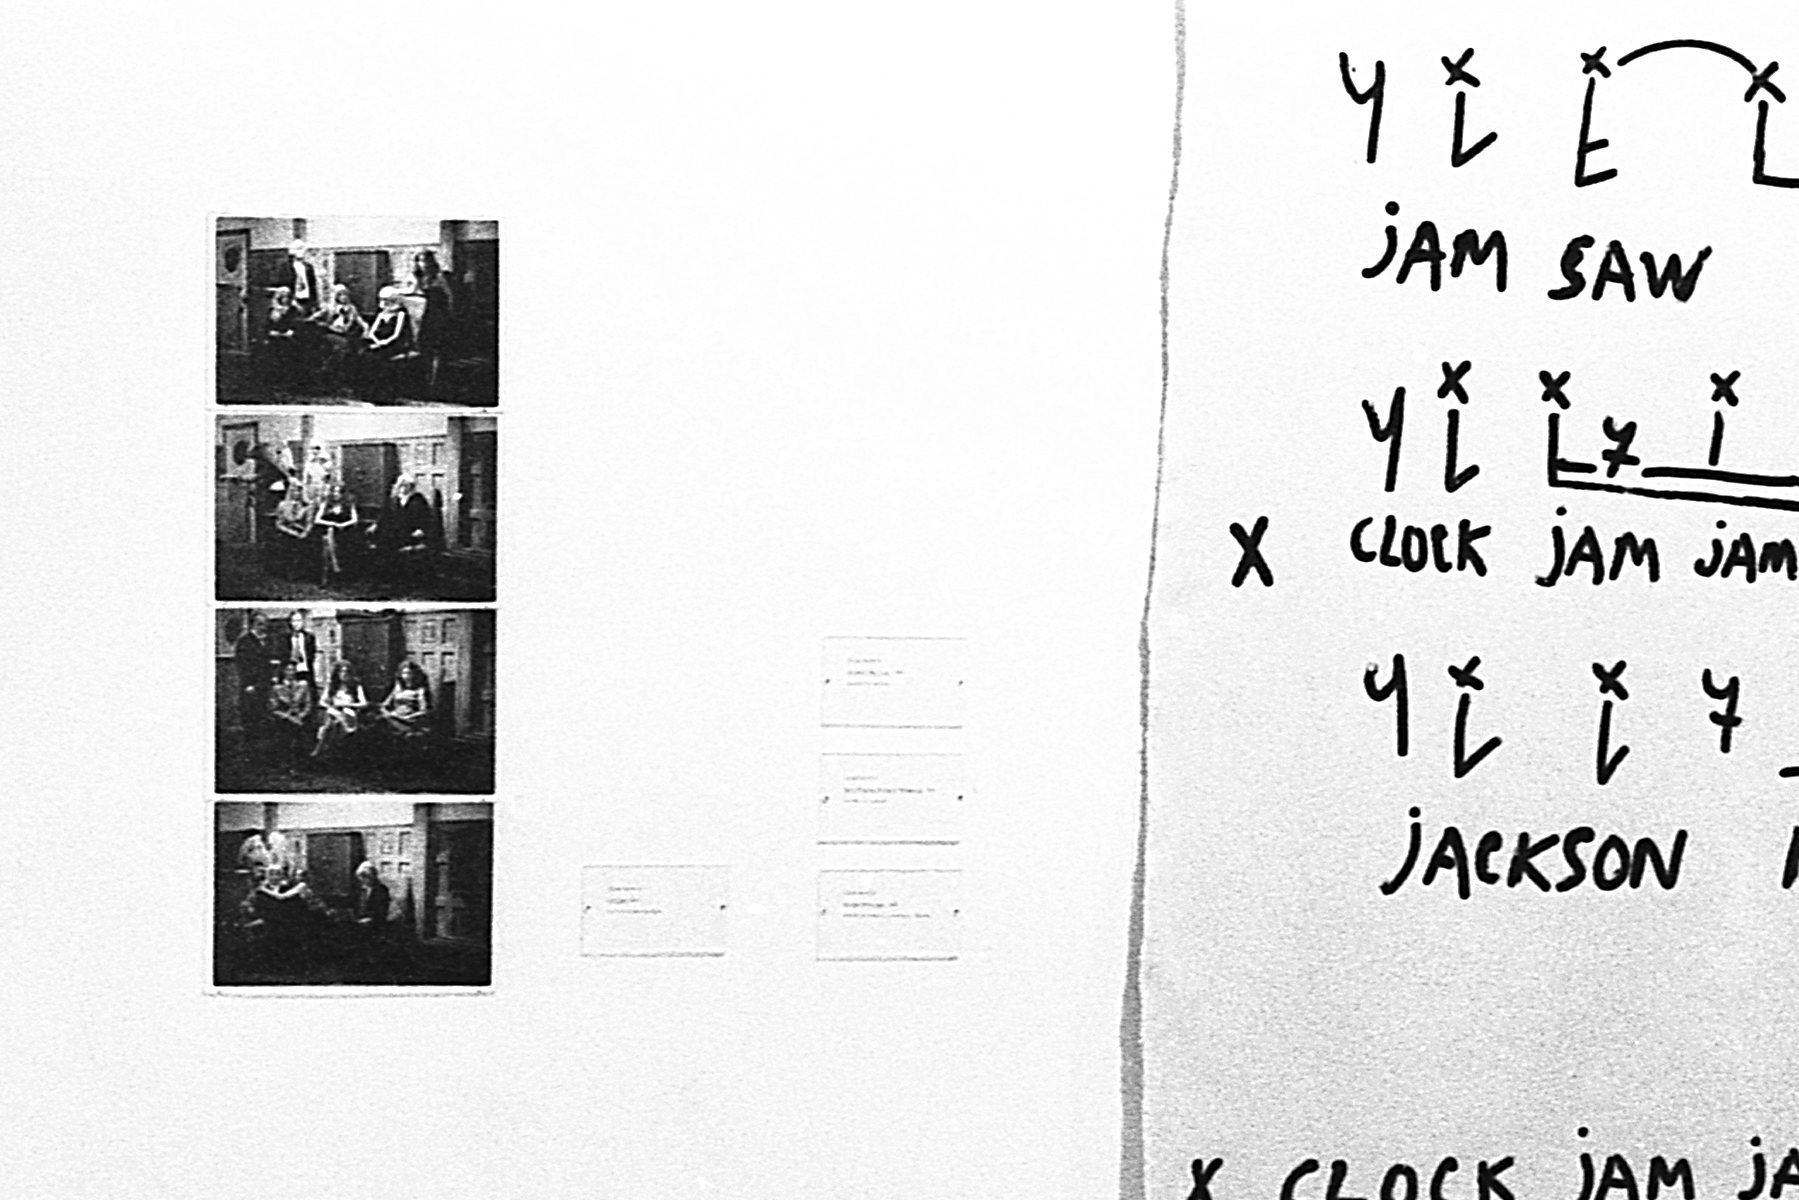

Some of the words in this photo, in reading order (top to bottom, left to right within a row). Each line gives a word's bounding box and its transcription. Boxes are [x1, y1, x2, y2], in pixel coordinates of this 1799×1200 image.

[1547, 234, 1713, 303] SAW
[1229, 515, 1274, 588] X
[1350, 514, 1492, 577] CLOCK
